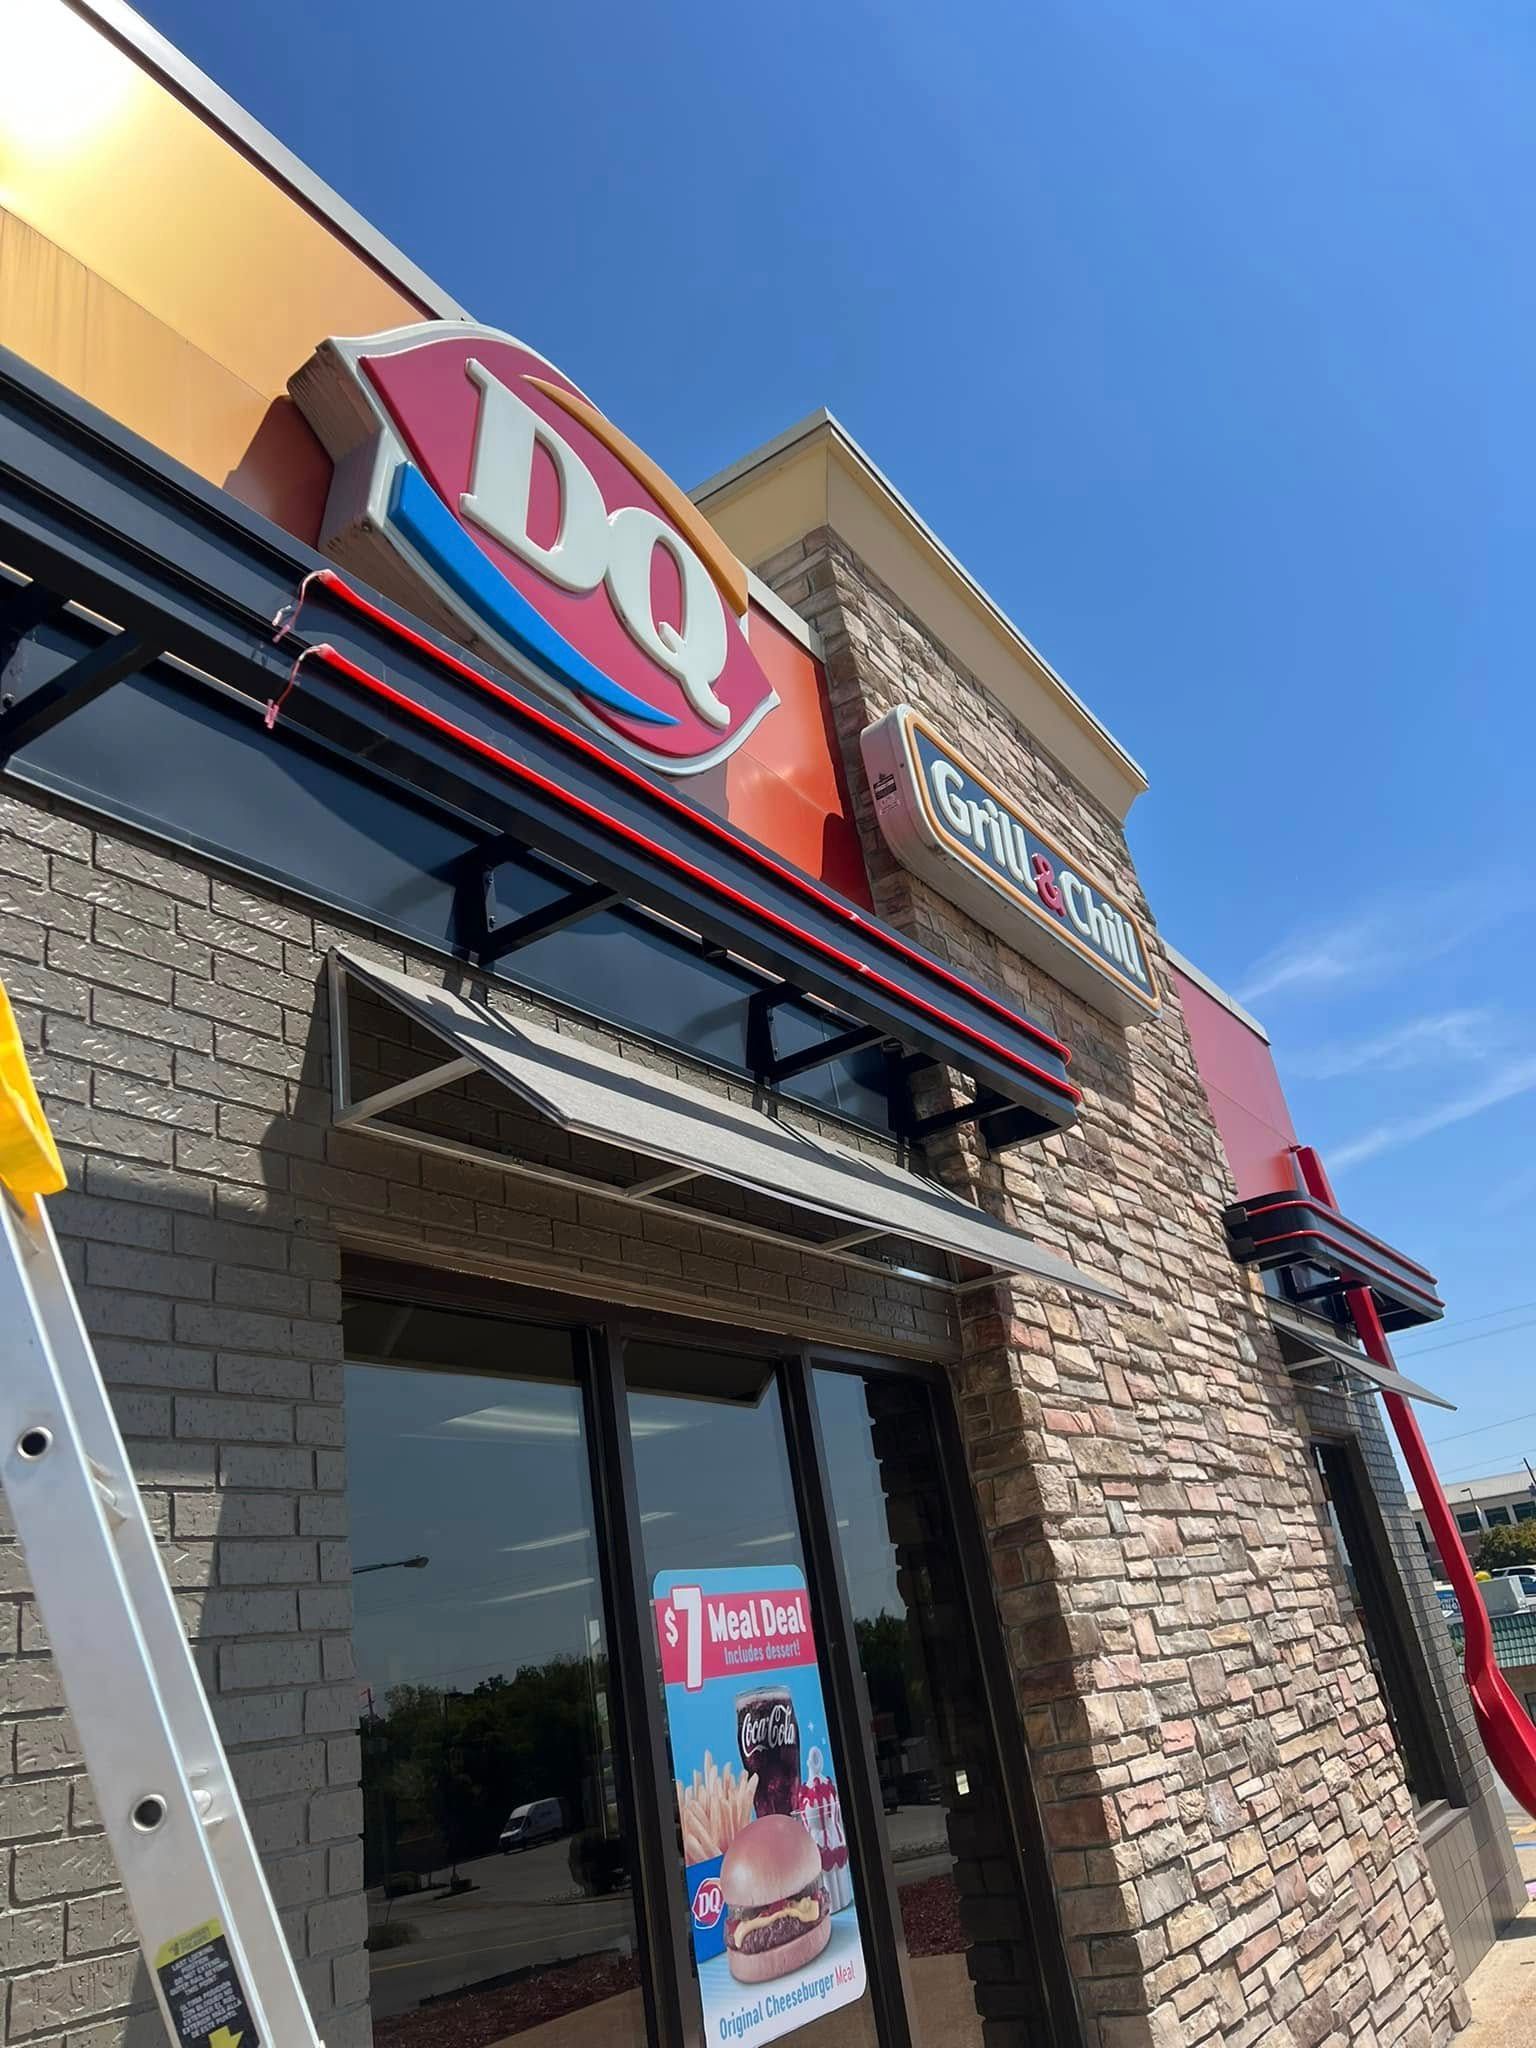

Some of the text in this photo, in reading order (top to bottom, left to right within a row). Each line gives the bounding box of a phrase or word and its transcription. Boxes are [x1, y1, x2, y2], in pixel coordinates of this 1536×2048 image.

[460, 358, 731, 730] DQ
[930, 759, 1147, 983] Grill & Chill
[707, 1600, 760, 1643] Meal
[760, 1597, 807, 1638] Deal
[724, 1639, 801, 1665] Includes dessert!
[741, 1704, 796, 1758] Coca-Cola
[699, 1887, 720, 1918] DQ
[719, 1960, 856, 2041] Original Cheeseburger Meal
